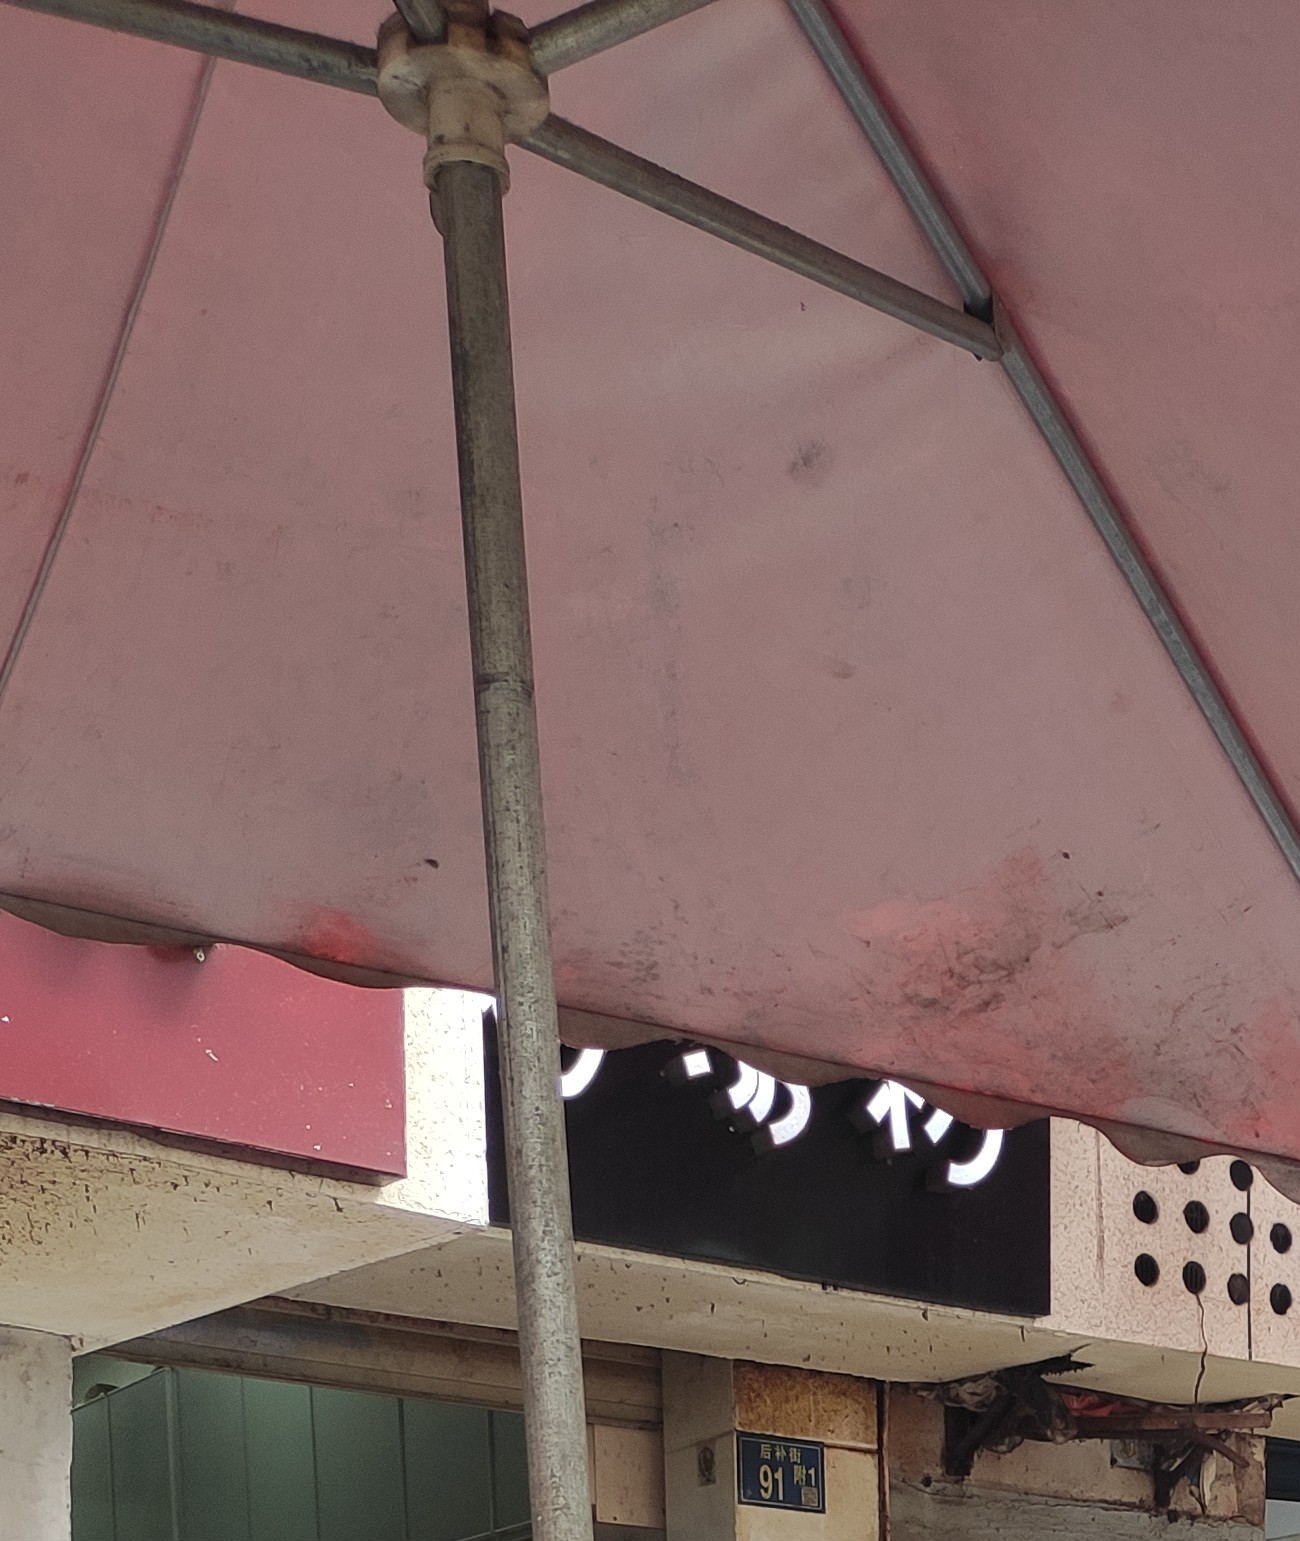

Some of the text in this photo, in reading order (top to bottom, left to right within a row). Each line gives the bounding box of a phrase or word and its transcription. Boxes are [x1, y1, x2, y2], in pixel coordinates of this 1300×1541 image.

[760, 1443, 802, 1464] 后补街
[759, 1464, 816, 1501] 91 附1
